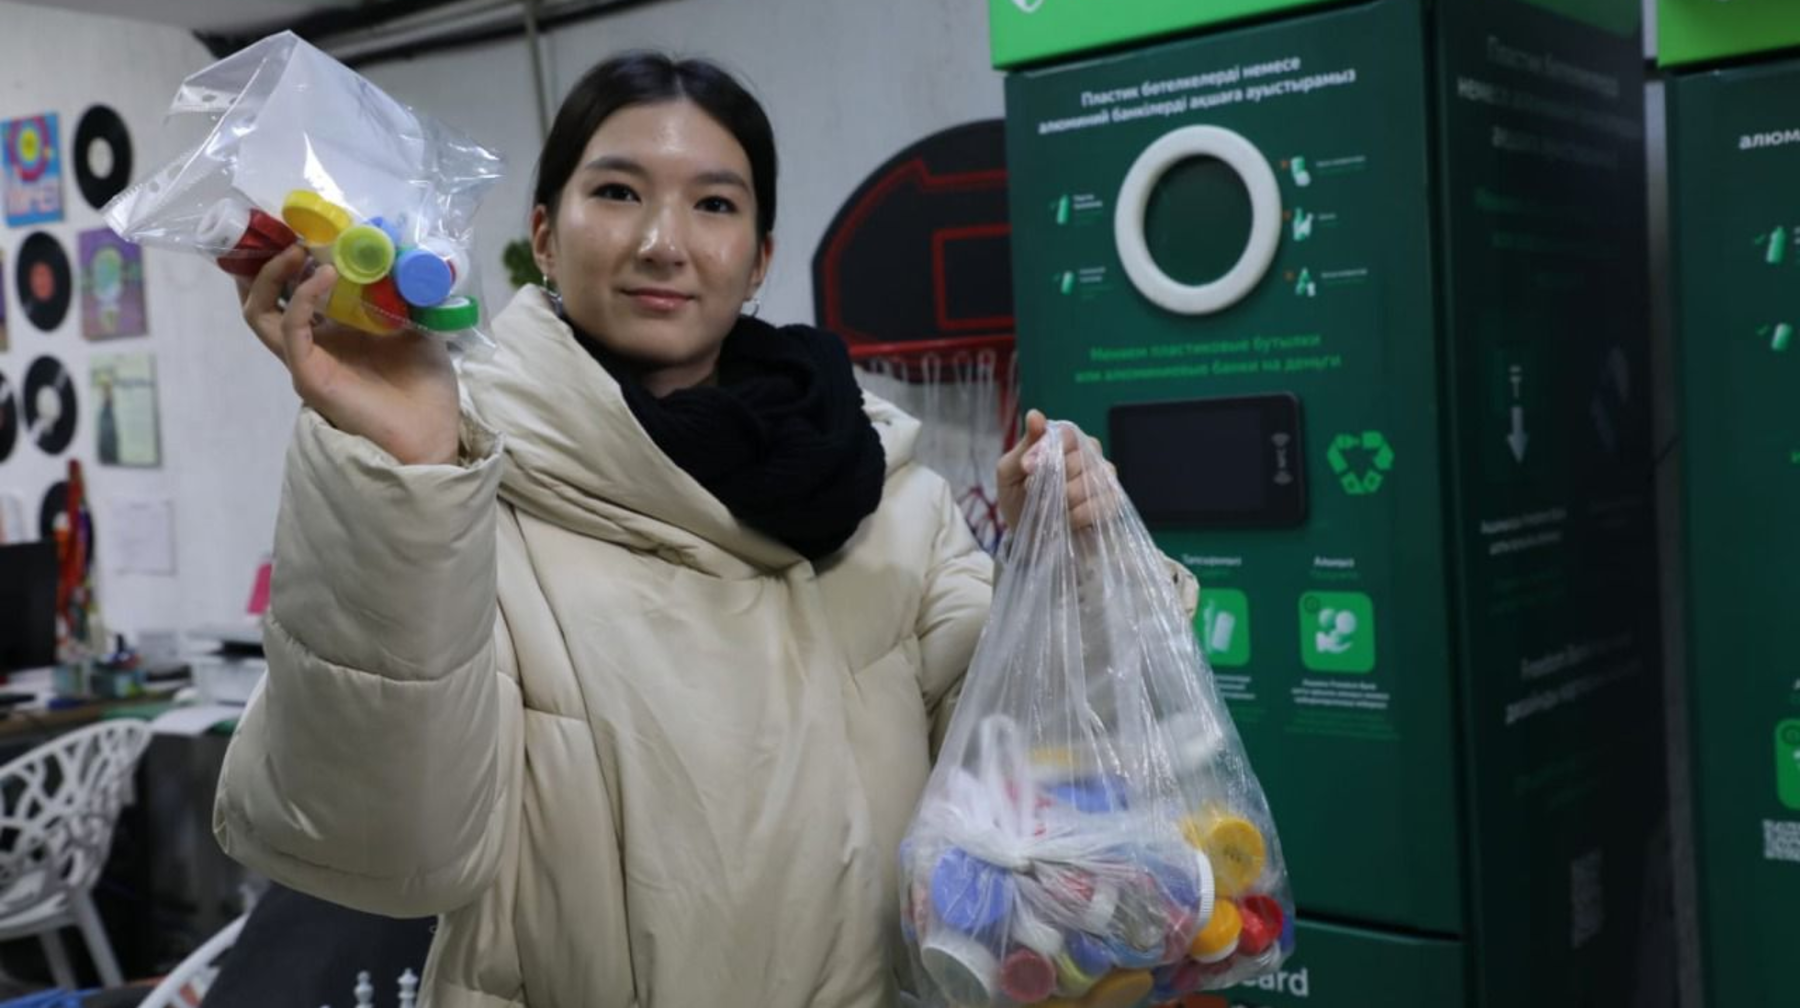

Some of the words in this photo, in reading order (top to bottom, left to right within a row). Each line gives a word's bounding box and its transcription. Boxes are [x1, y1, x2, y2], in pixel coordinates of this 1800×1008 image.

[1038, 110, 1109, 134] алюминий
[1112, 97, 1188, 123] банкілерді
[1246, 68, 1356, 101] ауыстырамыз
[1081, 86, 1139, 108] Пластик
[1243, 57, 1301, 79] немесе
[1151, 339, 1250, 359] пластиковые
[1253, 333, 1321, 354] бутылки
[1212, 356, 1259, 376] банки
[1262, 358, 1281, 372] на
[1284, 353, 1342, 374] деньги
